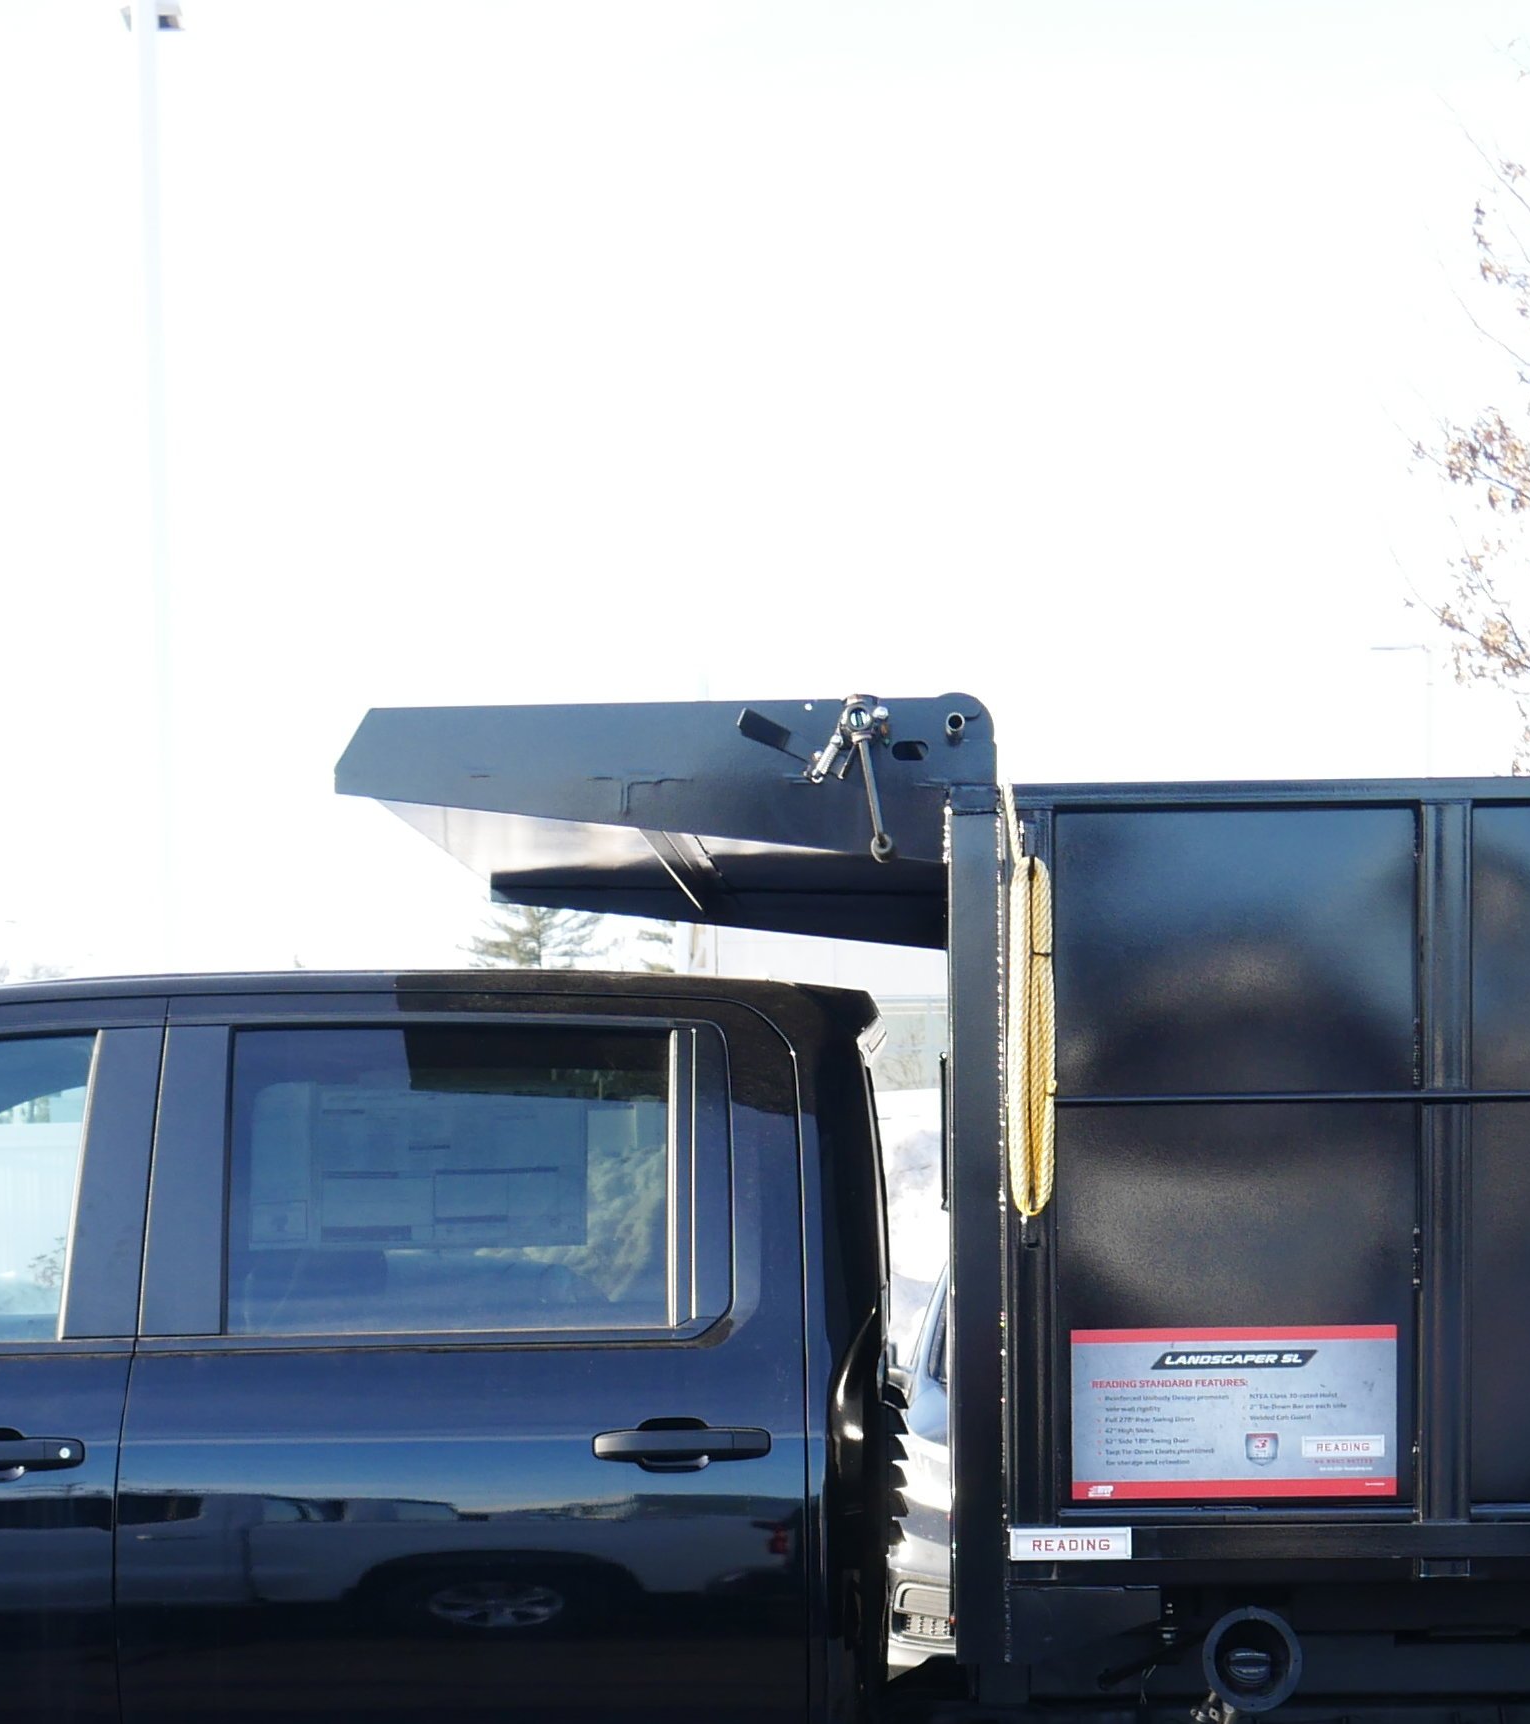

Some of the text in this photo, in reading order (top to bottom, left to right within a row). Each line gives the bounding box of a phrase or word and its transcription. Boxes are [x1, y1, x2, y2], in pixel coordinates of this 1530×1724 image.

[1165, 1353, 1303, 1366] LANDSCAPER SL
[1092, 1378, 1248, 1389] READING STANDARD FEATURES:
[1316, 1442, 1370, 1453] READING
[1032, 1538, 1110, 1552] READING
